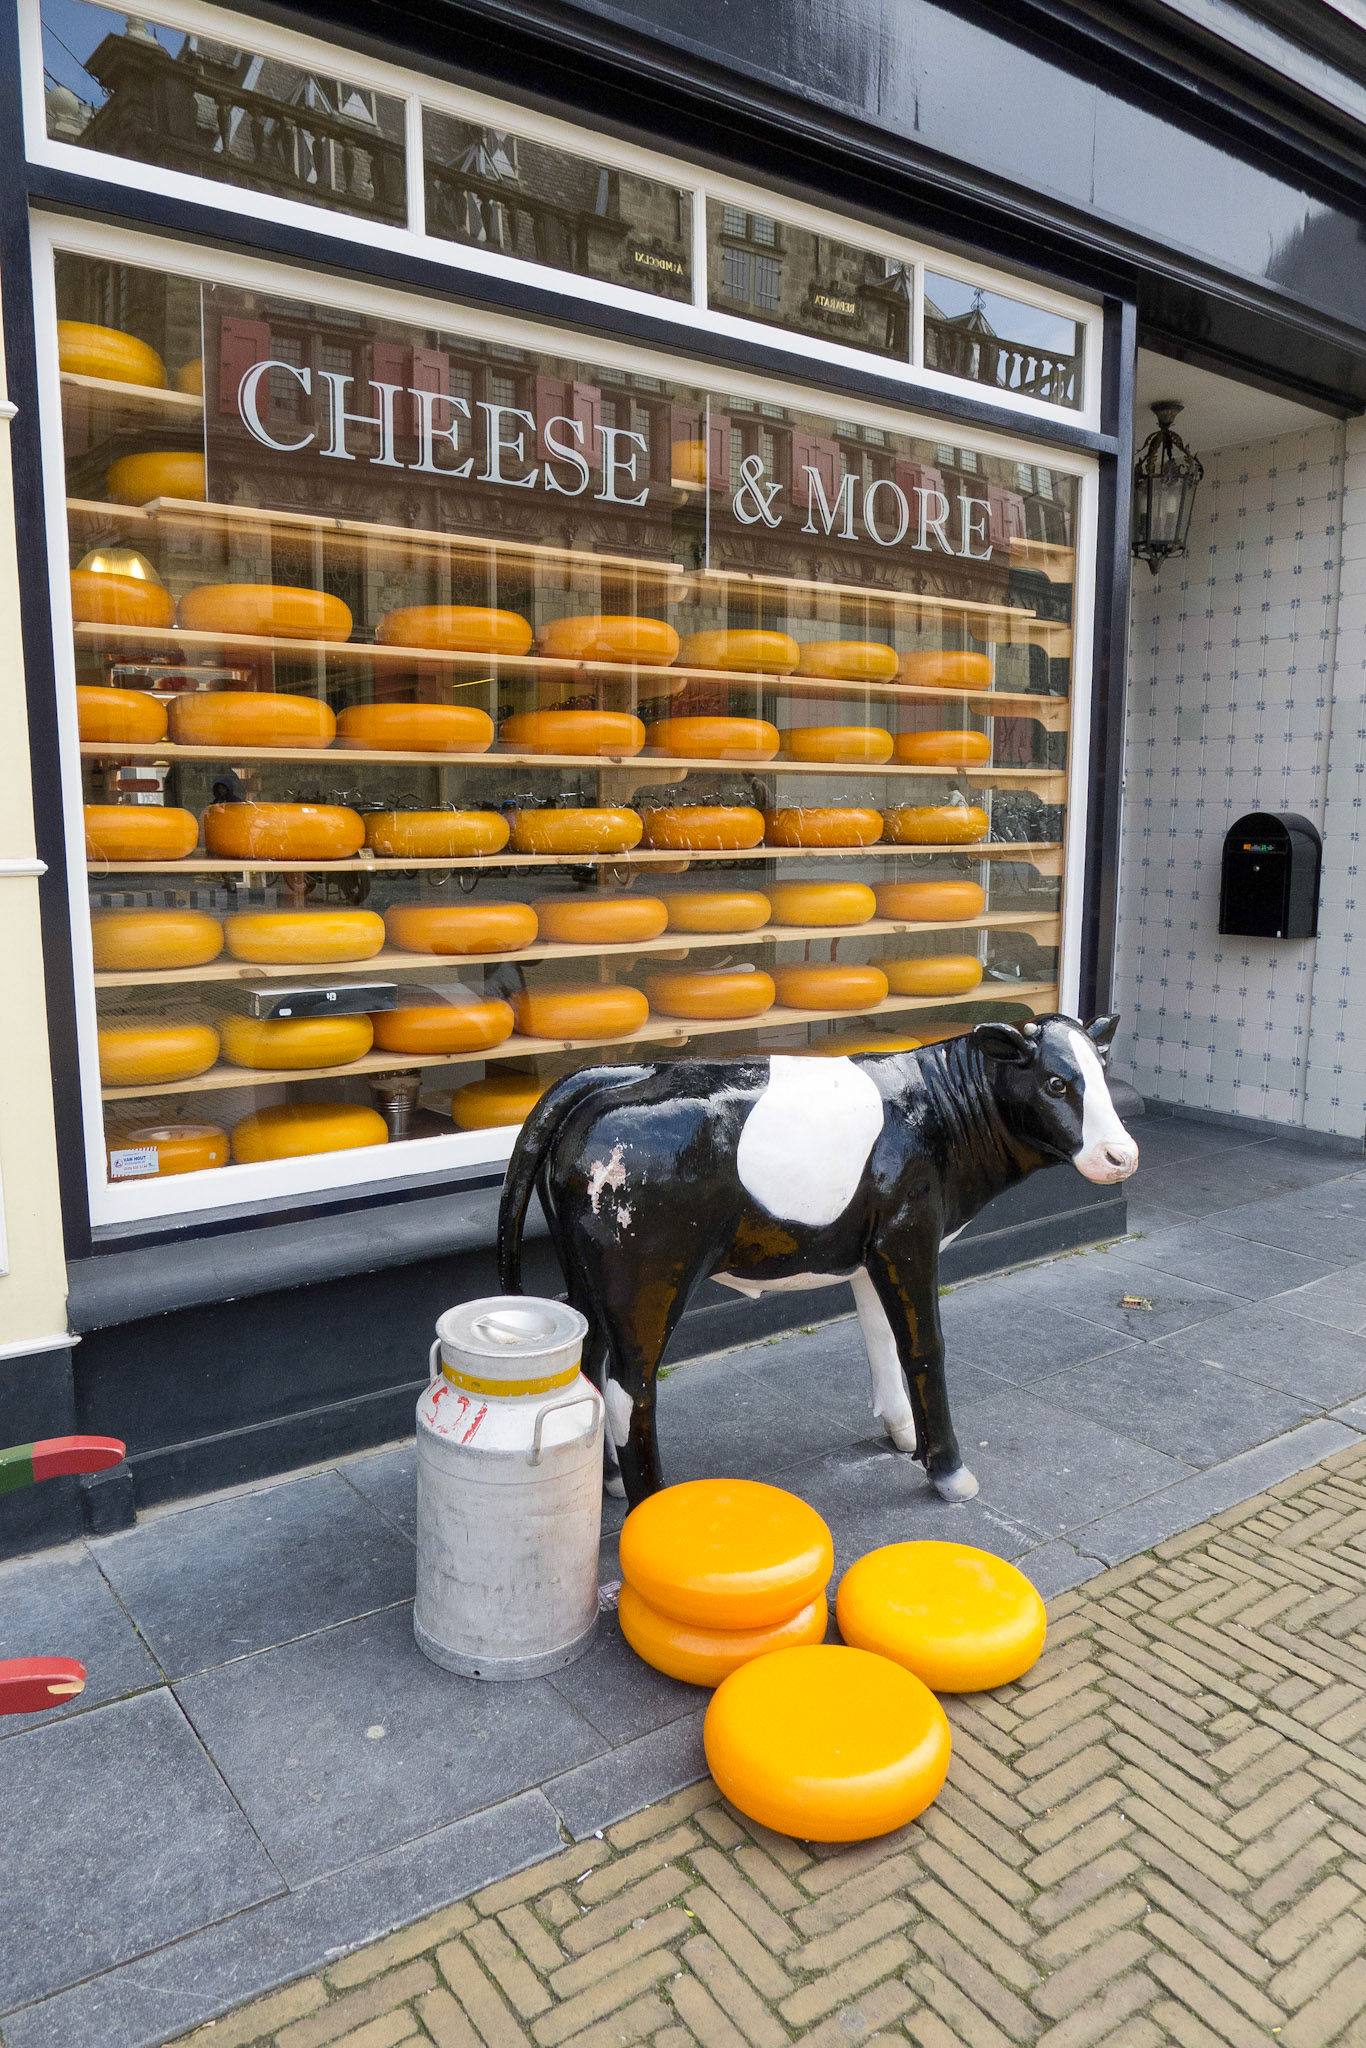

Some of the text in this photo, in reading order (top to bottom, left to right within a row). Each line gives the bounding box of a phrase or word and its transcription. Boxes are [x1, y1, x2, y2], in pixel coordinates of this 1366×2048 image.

[237, 360, 994, 561] CHEESE & MORE
